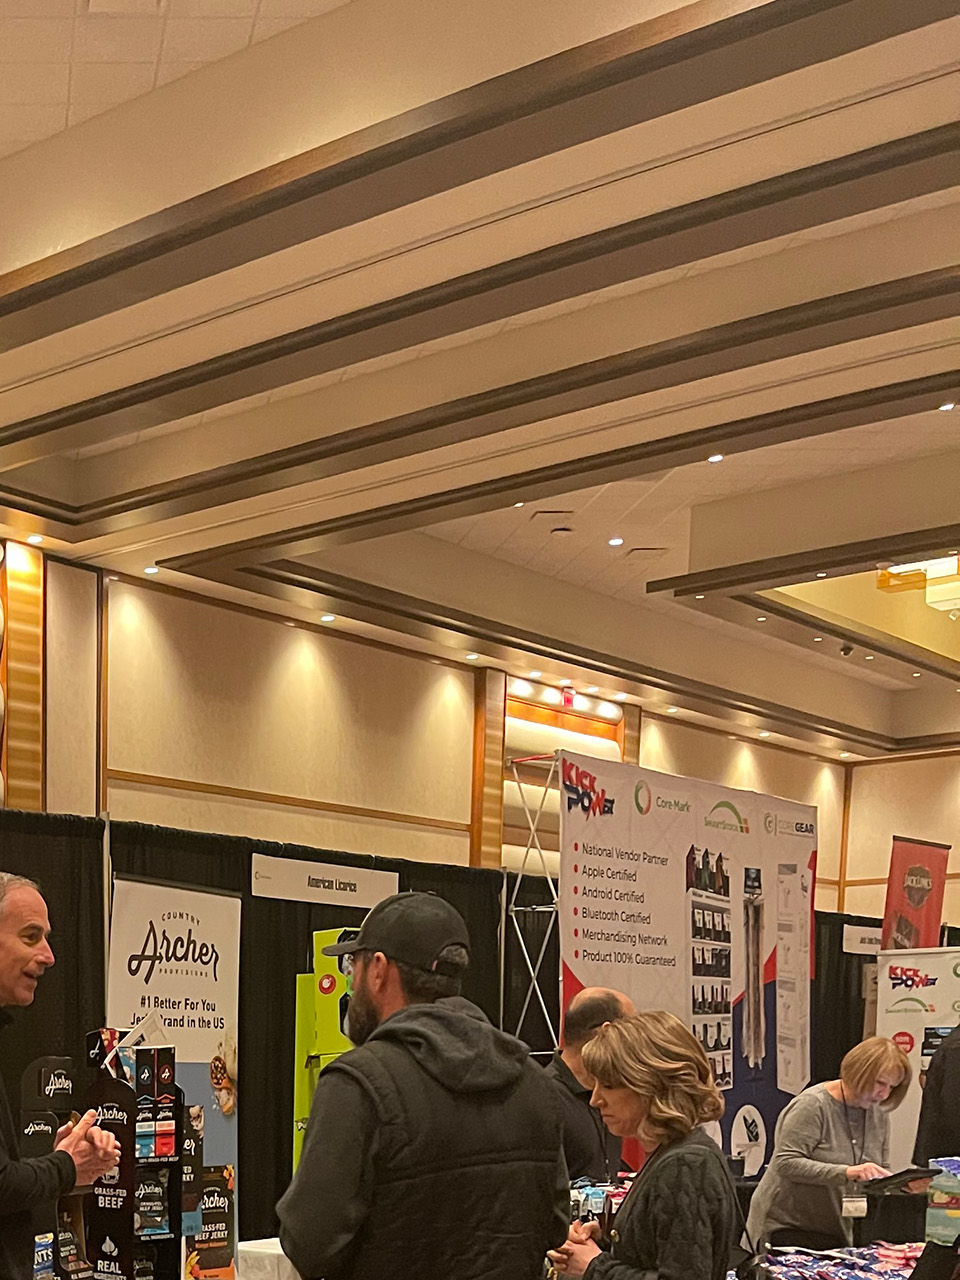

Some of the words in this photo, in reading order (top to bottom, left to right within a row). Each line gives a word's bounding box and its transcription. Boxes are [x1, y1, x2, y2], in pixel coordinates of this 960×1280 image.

[562, 757, 597, 794] KICK
[582, 843, 614, 858] National
[615, 848, 641, 862] Vendor
[642, 851, 669, 866] Partner
[582, 865, 604, 879] Apple
[606, 867, 637, 882] Certified
[307, 875, 334, 891] American
[335, 878, 357, 893] Licorice
[582, 886, 613, 900] Android
[614, 889, 645, 904] Certified
[161, 911, 200, 926] COUNTRY
[582, 907, 620, 922] Bluetooth
[621, 911, 651, 925] Certified
[582, 928, 637, 946] Merchandising
[638, 933, 668, 946] Network
[127, 920, 219, 985] Archer
[582, 950, 613, 963] Product
[613, 952, 633, 964] 100%
[635, 954, 676, 967] Guaranteed
[889, 965, 920, 978] KICK
[141, 995, 151, 1009] #1
[154, 996, 182, 1010] Better
[184, 998, 199, 1011] For
[201, 999, 216, 1012] You
[160, 1014, 185, 1027] rand
[187, 1016, 196, 1028] in
[198, 1016, 211, 1029] the
[213, 1017, 225, 1030] US
[45, 1073, 73, 1097] Archer
[96, 1106, 128, 1125] Archer
[24, 1122, 52, 1136] Archer
[94, 1187, 127, 1197] GRASS-FED
[134, 1183, 163, 1199] Archer
[98, 1196, 124, 1209] BEEF
[201, 1223, 226, 1232] RASS-FED
[210, 1230, 229, 1240] JERKY
[33, 1248, 53, 1265] NTS
[97, 1260, 122, 1274] REAL
